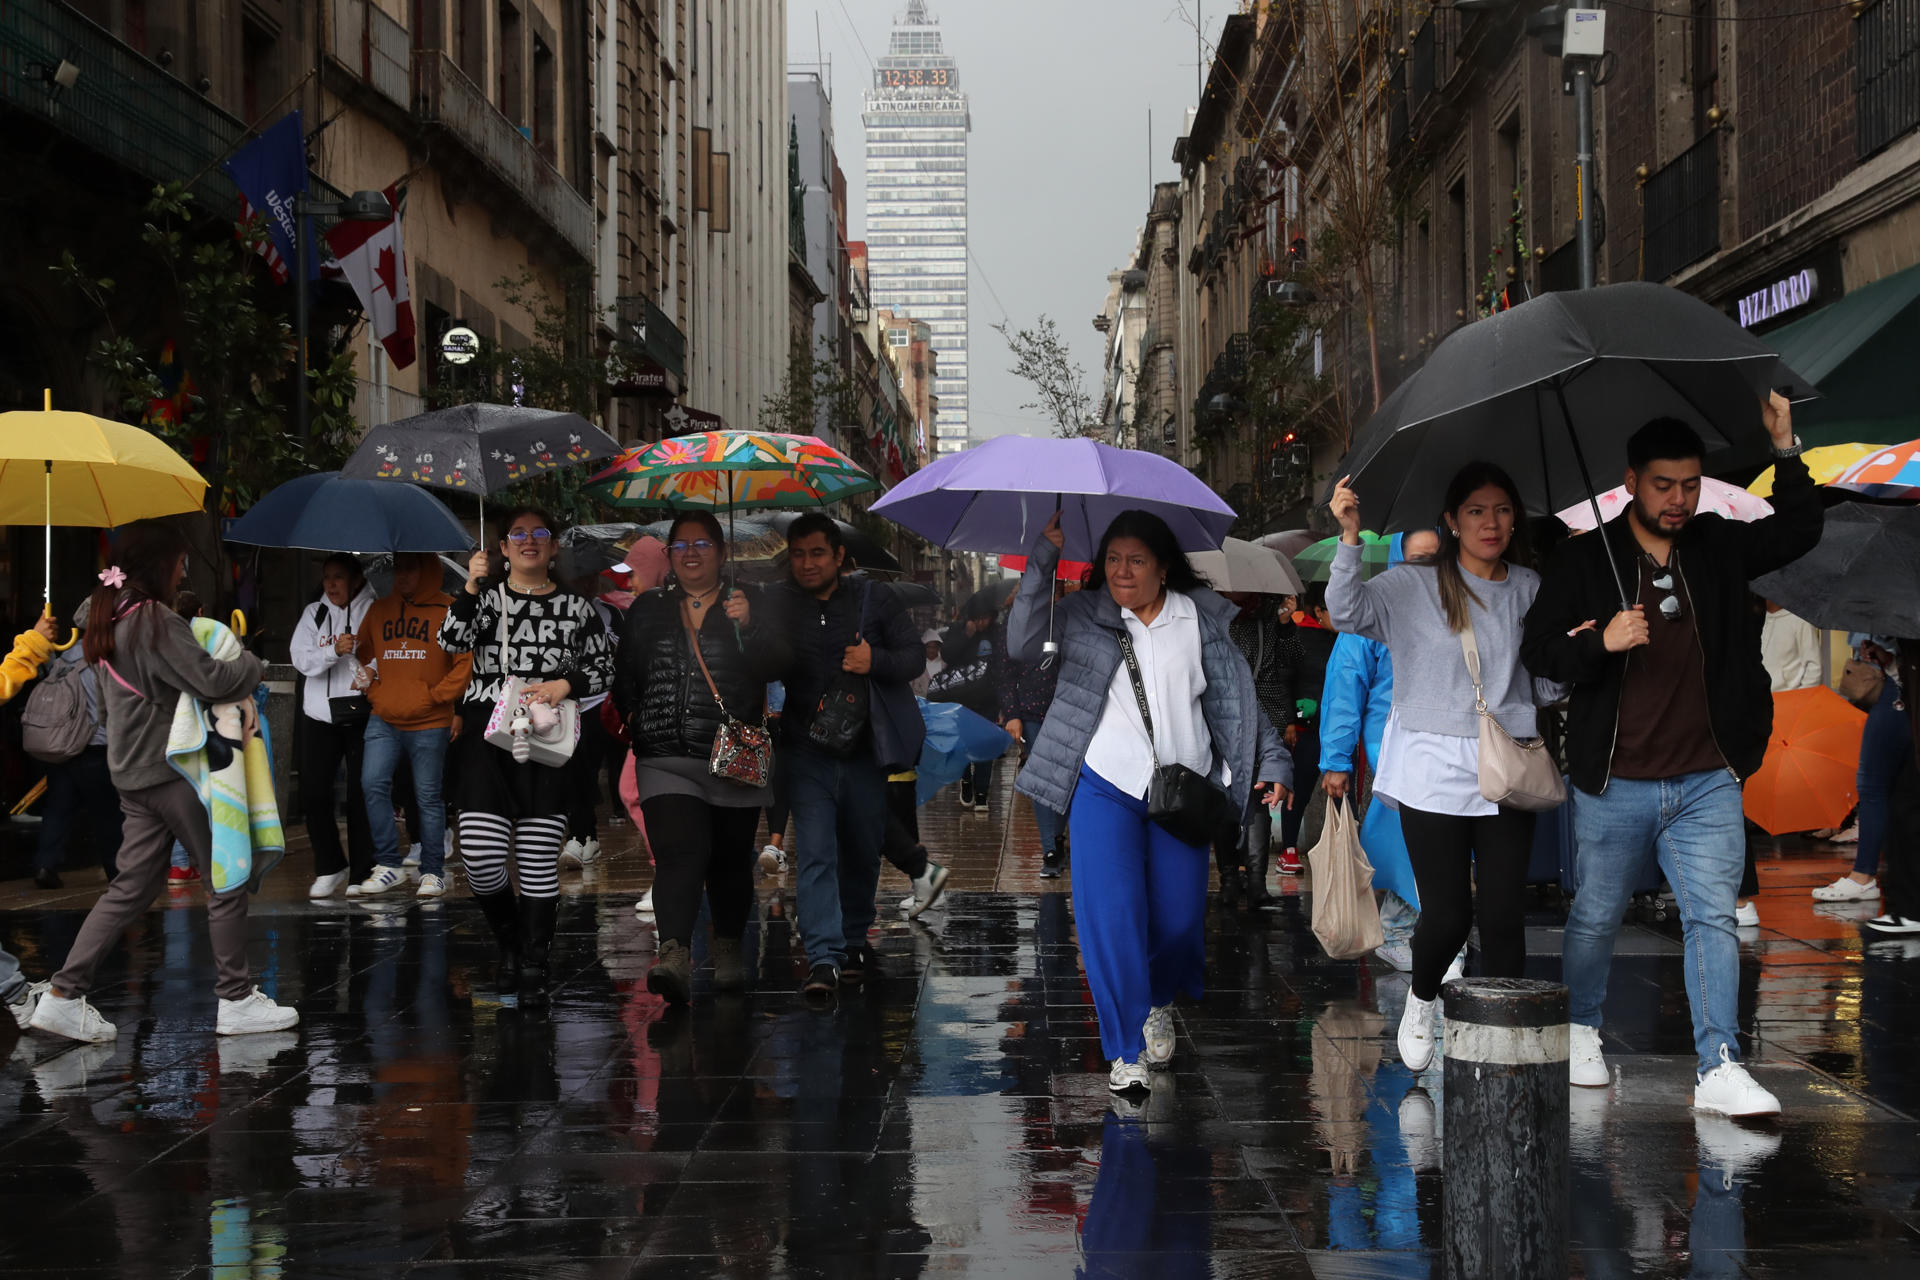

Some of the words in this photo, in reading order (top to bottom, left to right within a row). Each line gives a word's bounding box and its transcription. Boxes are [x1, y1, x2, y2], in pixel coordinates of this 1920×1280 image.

[870, 102, 960, 112] LATINOAMERICANA
[1738, 268, 1811, 329] BIZZARRO
[383, 617, 430, 643] GOGA
[494, 616, 580, 647] EART
[383, 649, 427, 660] ATHLETIC
[1121, 637, 1137, 670] NAUTICA
[1135, 681, 1149, 718] NAUTICA
